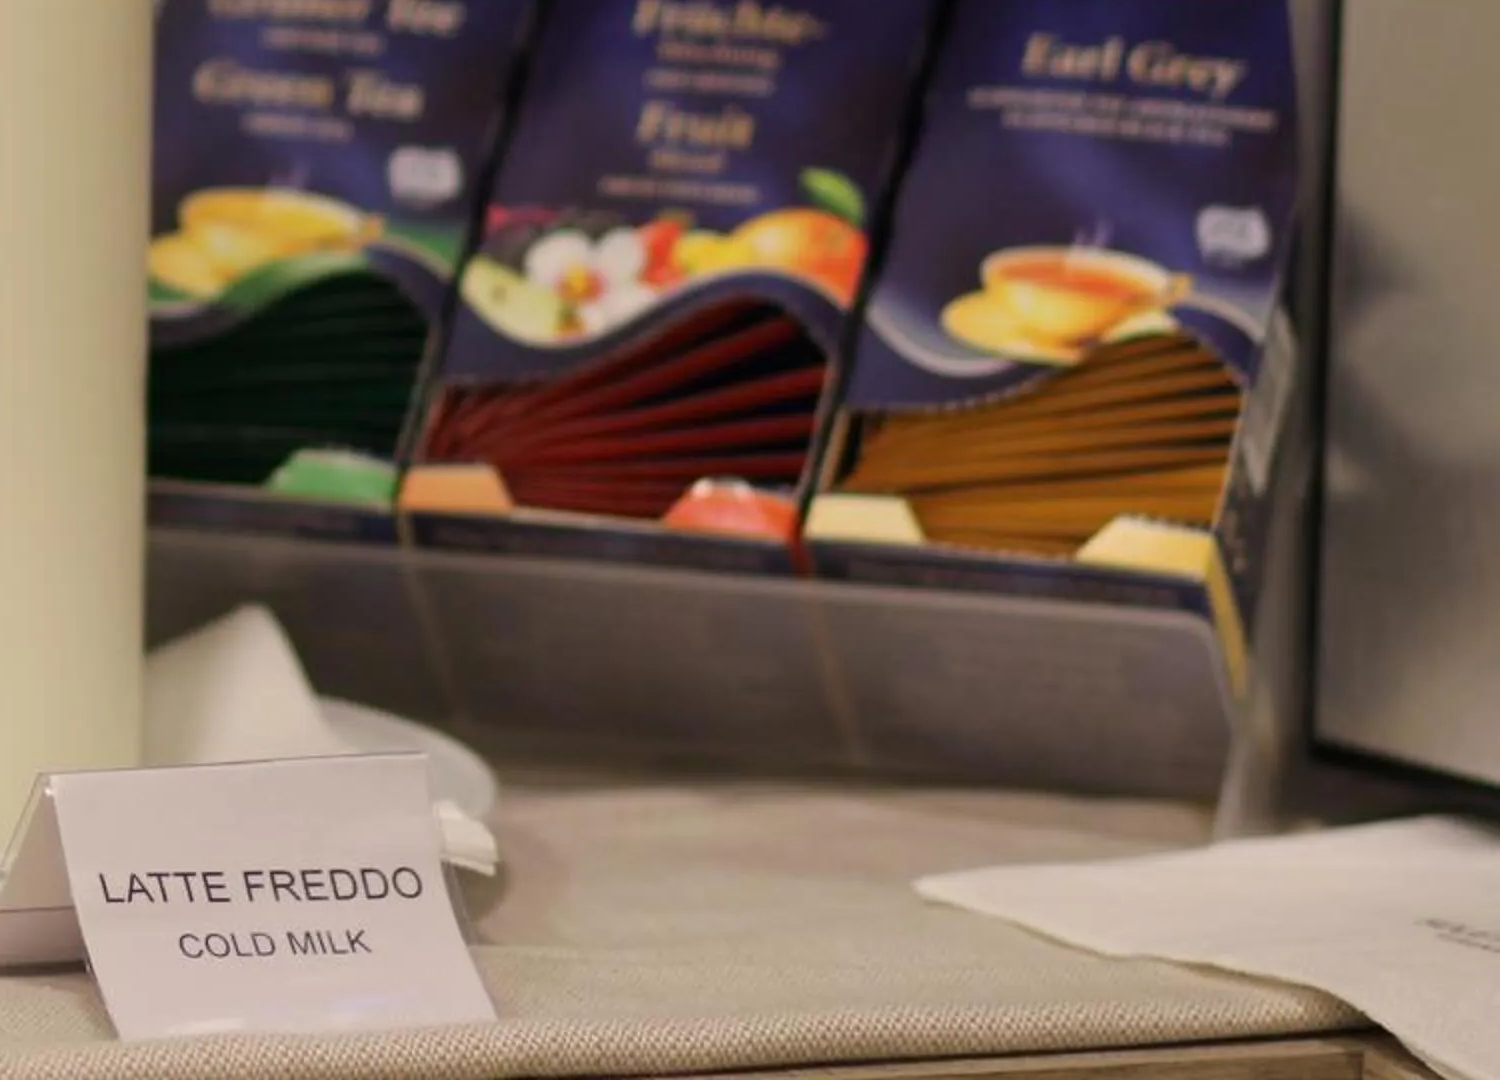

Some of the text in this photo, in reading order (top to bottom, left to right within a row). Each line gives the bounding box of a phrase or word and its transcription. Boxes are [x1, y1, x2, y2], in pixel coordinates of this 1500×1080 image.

[1021, 30, 1248, 101] Earl Grey
[99, 866, 423, 904] LATTE FREDDO
[178, 928, 373, 959] COLD MILK
